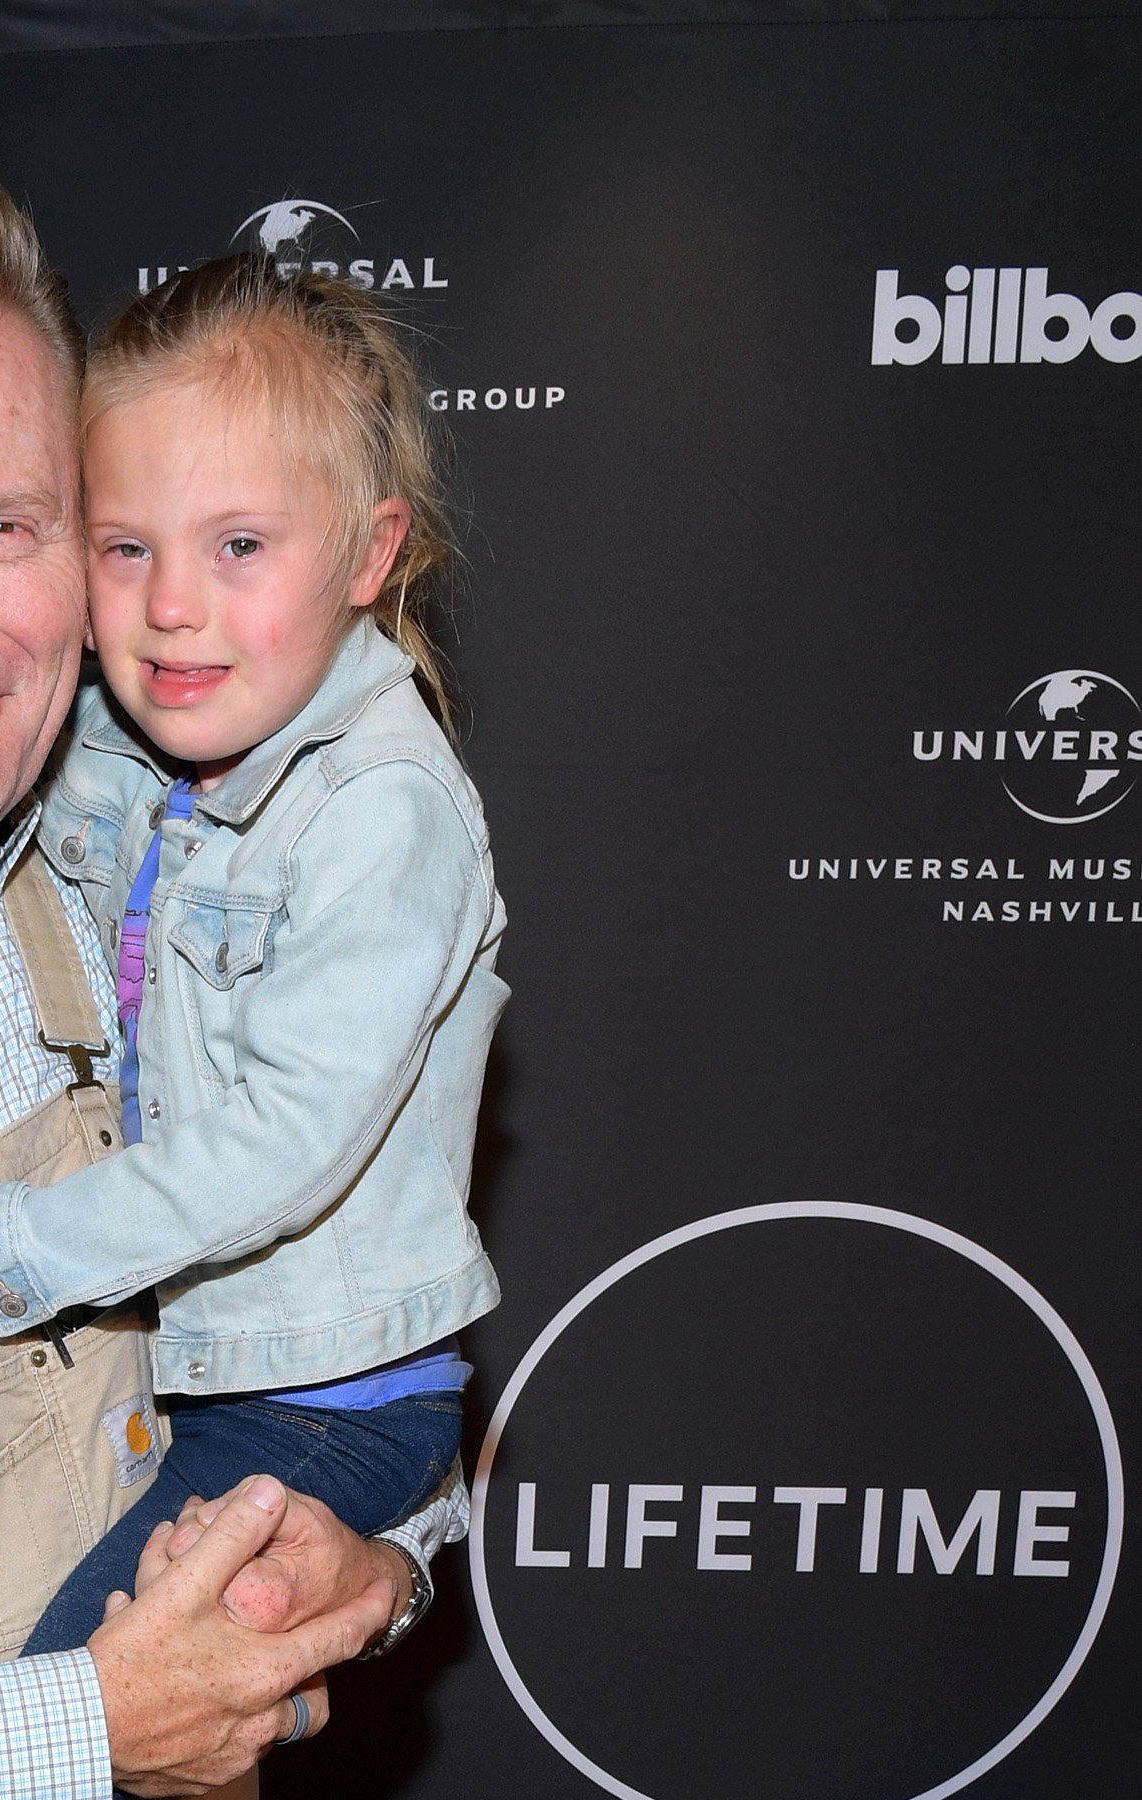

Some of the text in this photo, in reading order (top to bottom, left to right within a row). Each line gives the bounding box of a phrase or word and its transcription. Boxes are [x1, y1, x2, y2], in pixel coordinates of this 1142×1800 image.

[428, 386, 566, 412] GROUP
[788, 858, 1025, 880] UNIVERSAL
[514, 1482, 1077, 1578] LIFETIME
